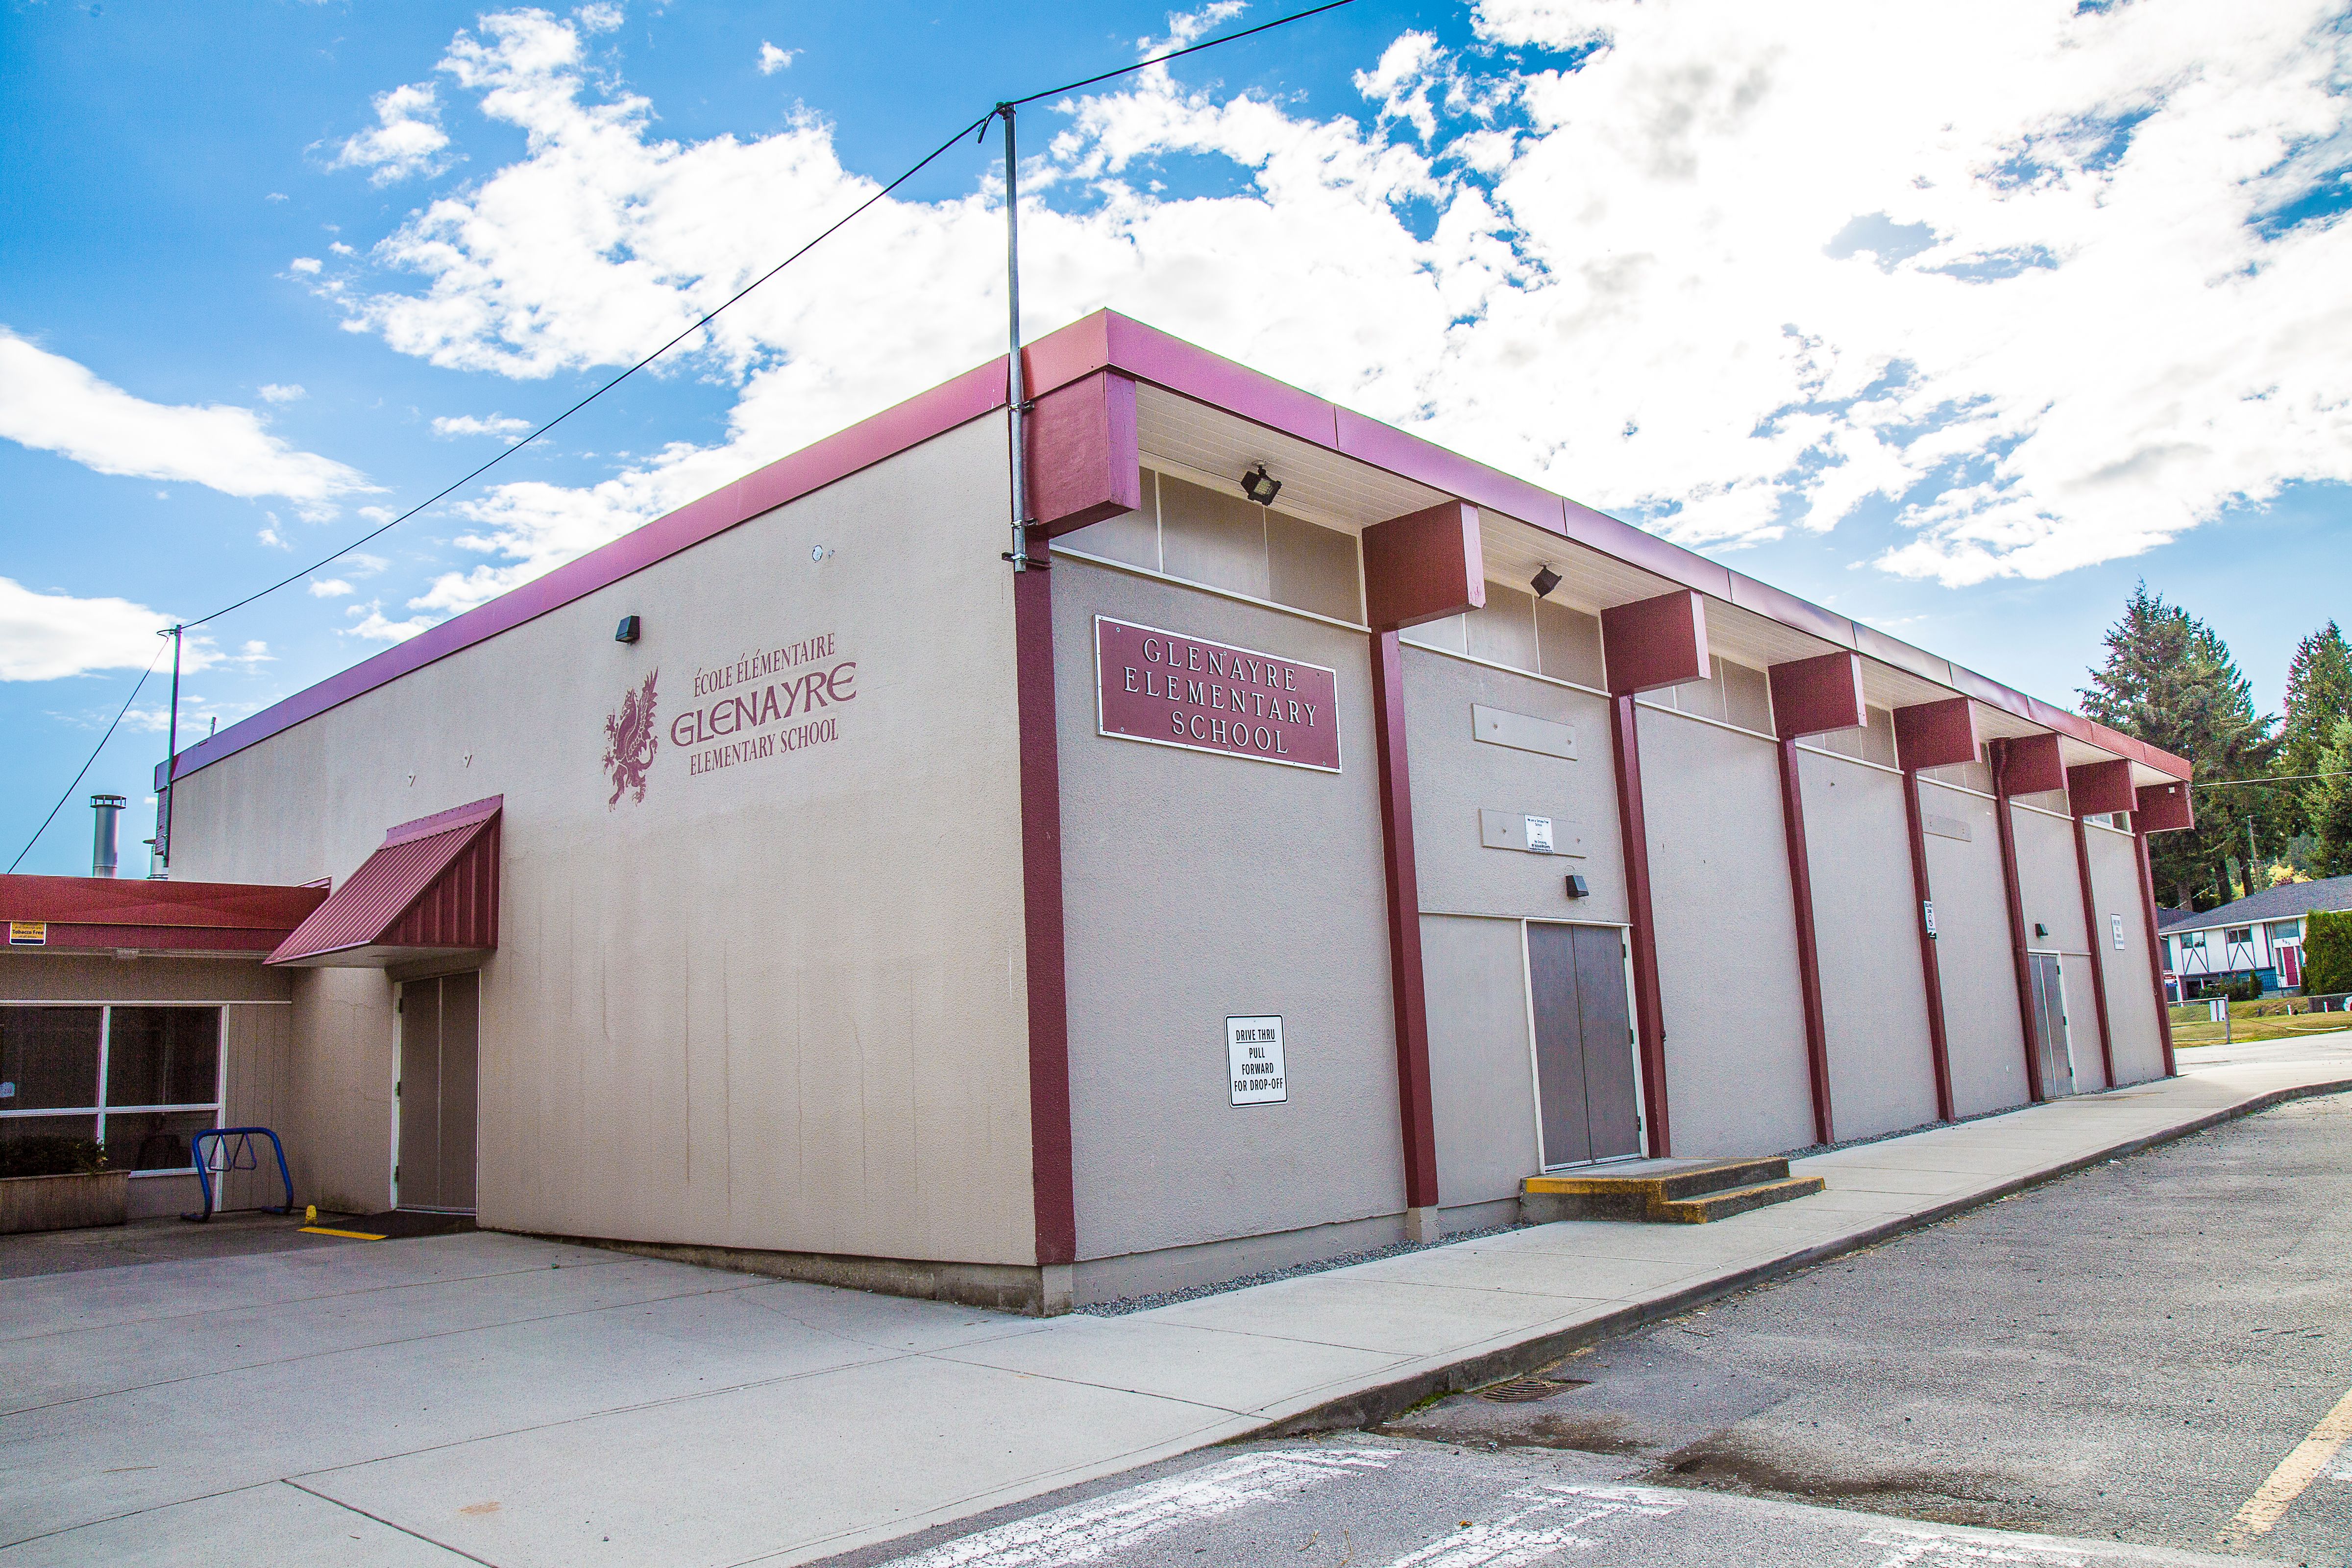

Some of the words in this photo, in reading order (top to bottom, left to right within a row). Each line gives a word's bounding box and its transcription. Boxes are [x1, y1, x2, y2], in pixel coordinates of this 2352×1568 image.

[694, 666, 733, 697] ÉCOLE
[736, 633, 835, 684] ÉLÉMENTAIRE
[1144, 638, 1297, 691] GLENAYRE
[670, 662, 857, 747] GLENAYRE
[1124, 666, 1316, 727] ELEMENTARY
[690, 734, 777, 776] ELEMENTARY
[781, 718, 838, 753] SCHOOL
[1172, 711, 1288, 754] SCHOOL
[1236, 1029, 1256, 1041] DRIVE
[1258, 1029, 1275, 1040] THRU
[1249, 1047, 1265, 1058] PULL
[1234, 1080, 1247, 1092] FOR
[1250, 1078, 1283, 1090] DROP-OFF
[1242, 1062, 1274, 1075] FORWARD
